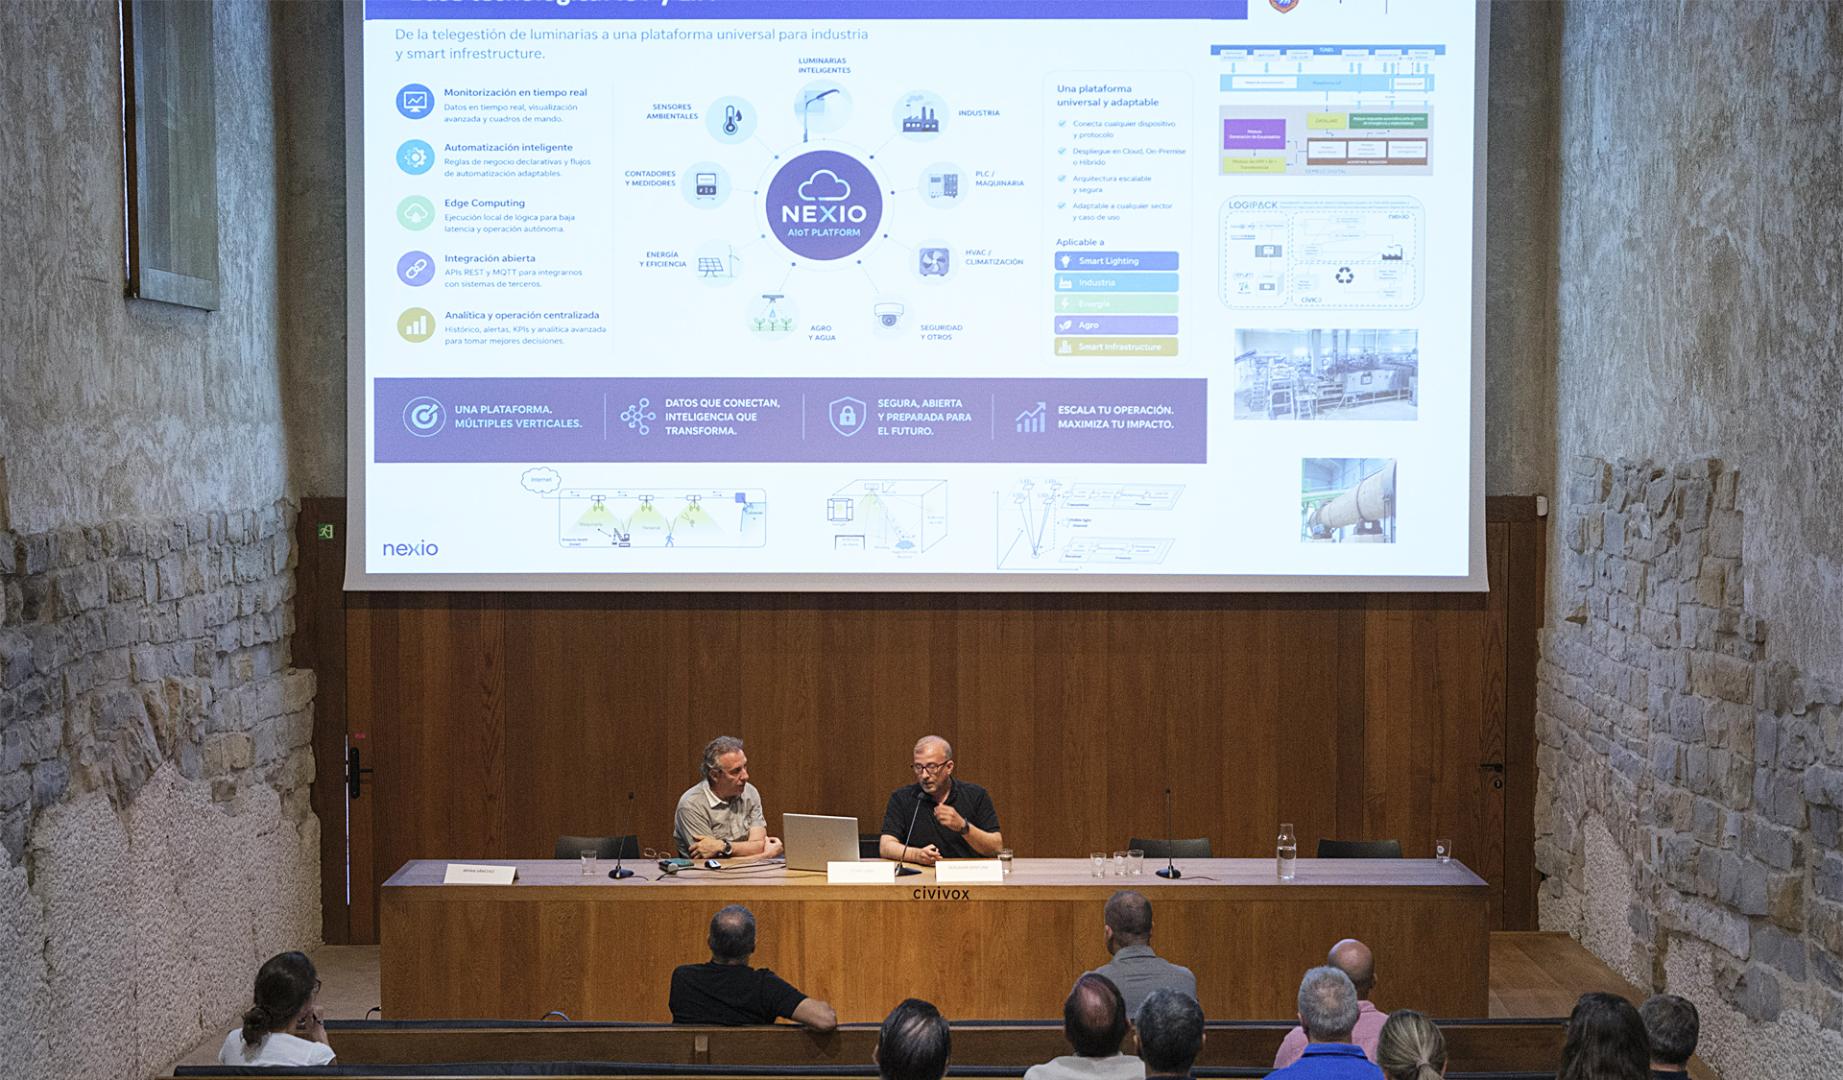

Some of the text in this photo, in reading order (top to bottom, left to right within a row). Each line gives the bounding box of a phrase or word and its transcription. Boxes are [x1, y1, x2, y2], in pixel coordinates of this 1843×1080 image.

[395, 28, 868, 43] De la telegestión de luminarias a una plataforma universal para industria
[395, 50, 404, 62] y
[406, 49, 446, 60] smart
[798, 66, 852, 74] INTELIGENTES
[444, 88, 517, 97] Monitorización
[533, 89, 568, 98] tiempo
[569, 88, 588, 96] real
[1057, 84, 1132, 95] Una plataforma
[444, 103, 468, 111] Datos
[480, 104, 509, 112] tiempo
[509, 104, 527, 112] real,
[528, 103, 578, 111] visualización
[1057, 98, 1159, 108] universal y adaptable
[444, 115, 481, 123] avanzada
[534, 115, 563, 123] mando.
[646, 112, 698, 120] AMBIENTALES
[1072, 120, 1103, 128] Conecta
[444, 143, 573, 154] Automatización inteligente
[444, 158, 470, 167] Reglas
[471, 158, 482, 166] de
[515, 158, 562, 166] declarativas
[570, 158, 592, 167] flujos
[624, 170, 676, 178] CONTADORES
[975, 170, 990, 178] PLC
[1072, 175, 1118, 183] Arquitectura
[444, 198, 526, 209] Edge Computing
[444, 214, 482, 222] Ejecución
[514, 214, 539, 223] lógica
[558, 214, 576, 222] baja
[782, 204, 867, 223] NEXIO
[482, 226, 522, 234] operación
[811, 228, 861, 237] PLATFORM
[1056, 238, 1098, 247] Aplicable
[965, 248, 986, 256] HVAC
[444, 254, 536, 264] Integración abierta
[646, 260, 687, 268] EFICIENCIA
[965, 258, 1024, 266] CLIMATIZACIÓN
[1079, 256, 1140, 266] Smart Lighting
[1079, 279, 1116, 287] Industria
[444, 311, 600, 321] Analítica y operación centralizada
[810, 324, 832, 332] AGRO
[1078, 321, 1100, 330] Agro
[444, 338, 463, 346] para
[489, 338, 520, 346] mejores
[926, 333, 952, 341] OTROS
[1078, 342, 1162, 351] Smart Infrastructure
[665, 398, 780, 408] DATOS QUE CONECTAN,
[878, 398, 963, 408] SEGURA, ABIERTA
[455, 404, 553, 414] UNA PLATAFORMA.
[1058, 404, 1174, 415] ESCALA TU OPERACIÓN.
[665, 412, 757, 422] INTELIGENCIA QUE
[878, 412, 972, 422] Y PREPARADA PARA
[455, 418, 583, 428] MÚLTIPLES VERTICALES.
[1058, 419, 1174, 429] MAXIMIZA TU IMPACTO.
[665, 426, 737, 436] TRANSFORMA.
[878, 426, 934, 436] EL FUTURO.
[383, 539, 439, 556] nexio
[913, 886, 970, 900] civivox
